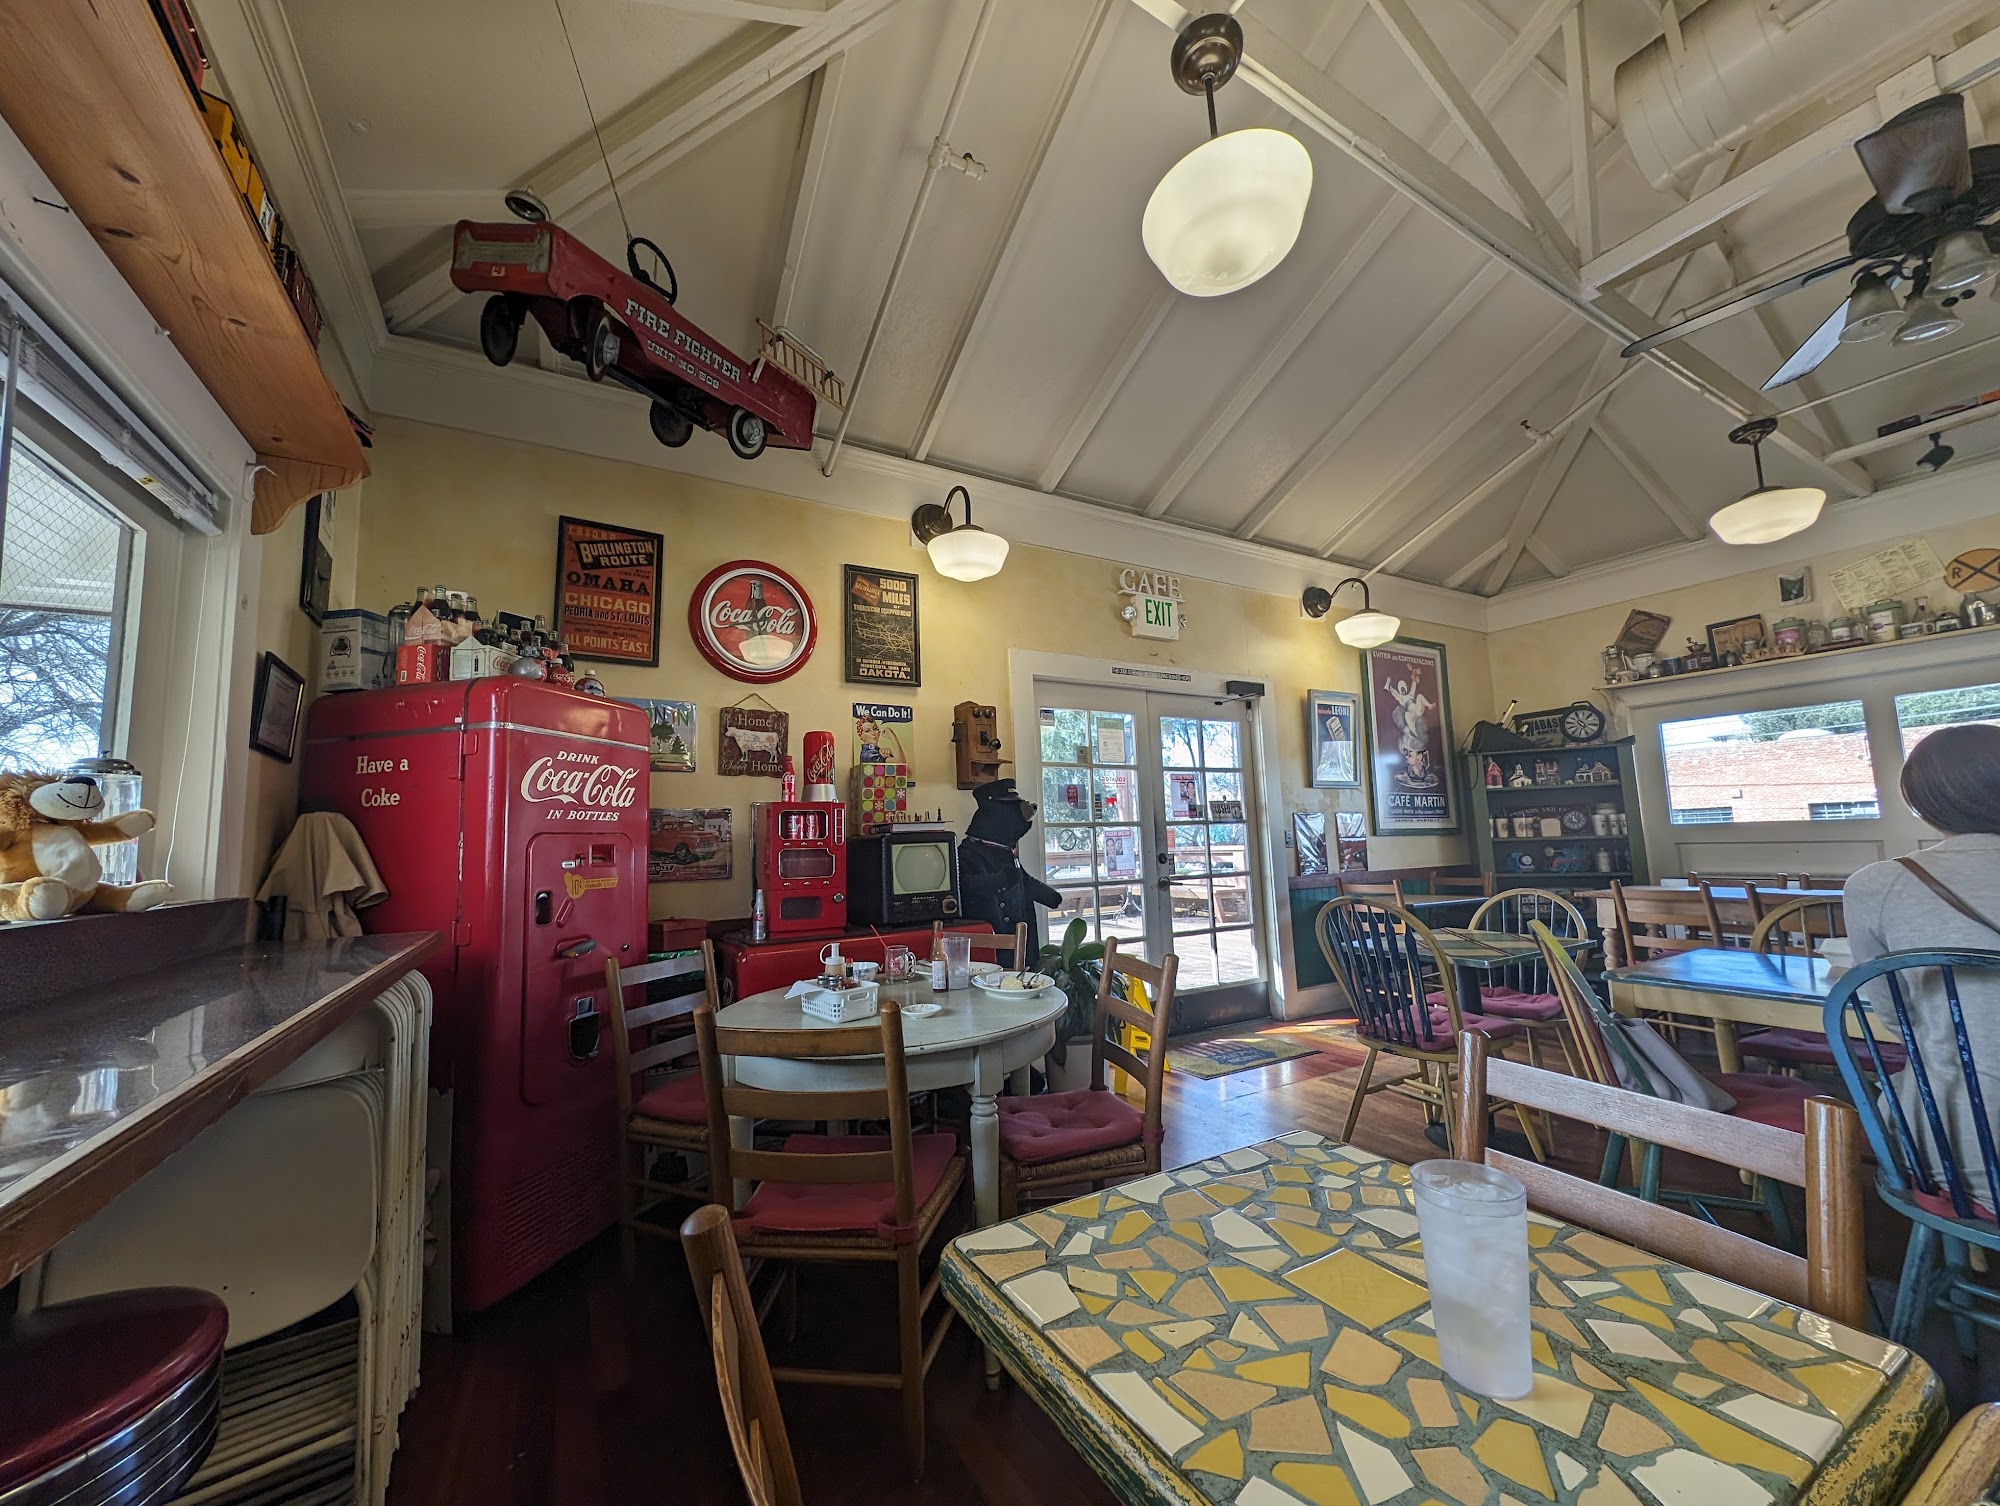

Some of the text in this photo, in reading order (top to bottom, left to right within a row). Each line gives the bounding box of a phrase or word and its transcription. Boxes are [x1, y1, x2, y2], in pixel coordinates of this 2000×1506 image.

[625, 298, 741, 383] FIRE FIGHTER
[647, 340, 676, 363] UNIT
[579, 541, 655, 563] BURLINGTON
[599, 555, 649, 567] ROUTE
[1951, 567, 1962, 579] R
[566, 571, 650, 596] OMAHA
[880, 578, 907, 592] 5000
[1120, 568, 1182, 598] CAFE
[565, 592, 651, 615] CHICAGO
[882, 591, 911, 606] MILES
[564, 605, 593, 618] PEORIA
[595, 611, 609, 620] and
[624, 614, 650, 627] LOUIS
[1145, 599, 1172, 627] EXIT
[564, 634, 582, 646] ALL
[583, 637, 619, 651] POINTS
[860, 668, 911, 679] DAKOTA.
[856, 705, 911, 719] We Can Do It!
[1332, 705, 1350, 717] LEONE
[738, 714, 772, 727] Home
[356, 755, 409, 775] Have a
[557, 750, 600, 765] DRINK
[752, 760, 783, 772] Home
[521, 756, 640, 808] Coca-Cola
[361, 787, 401, 808] Coke
[1388, 793, 1446, 808] CAFÉ MARTIN
[546, 810, 620, 822] IN BOTTLES
